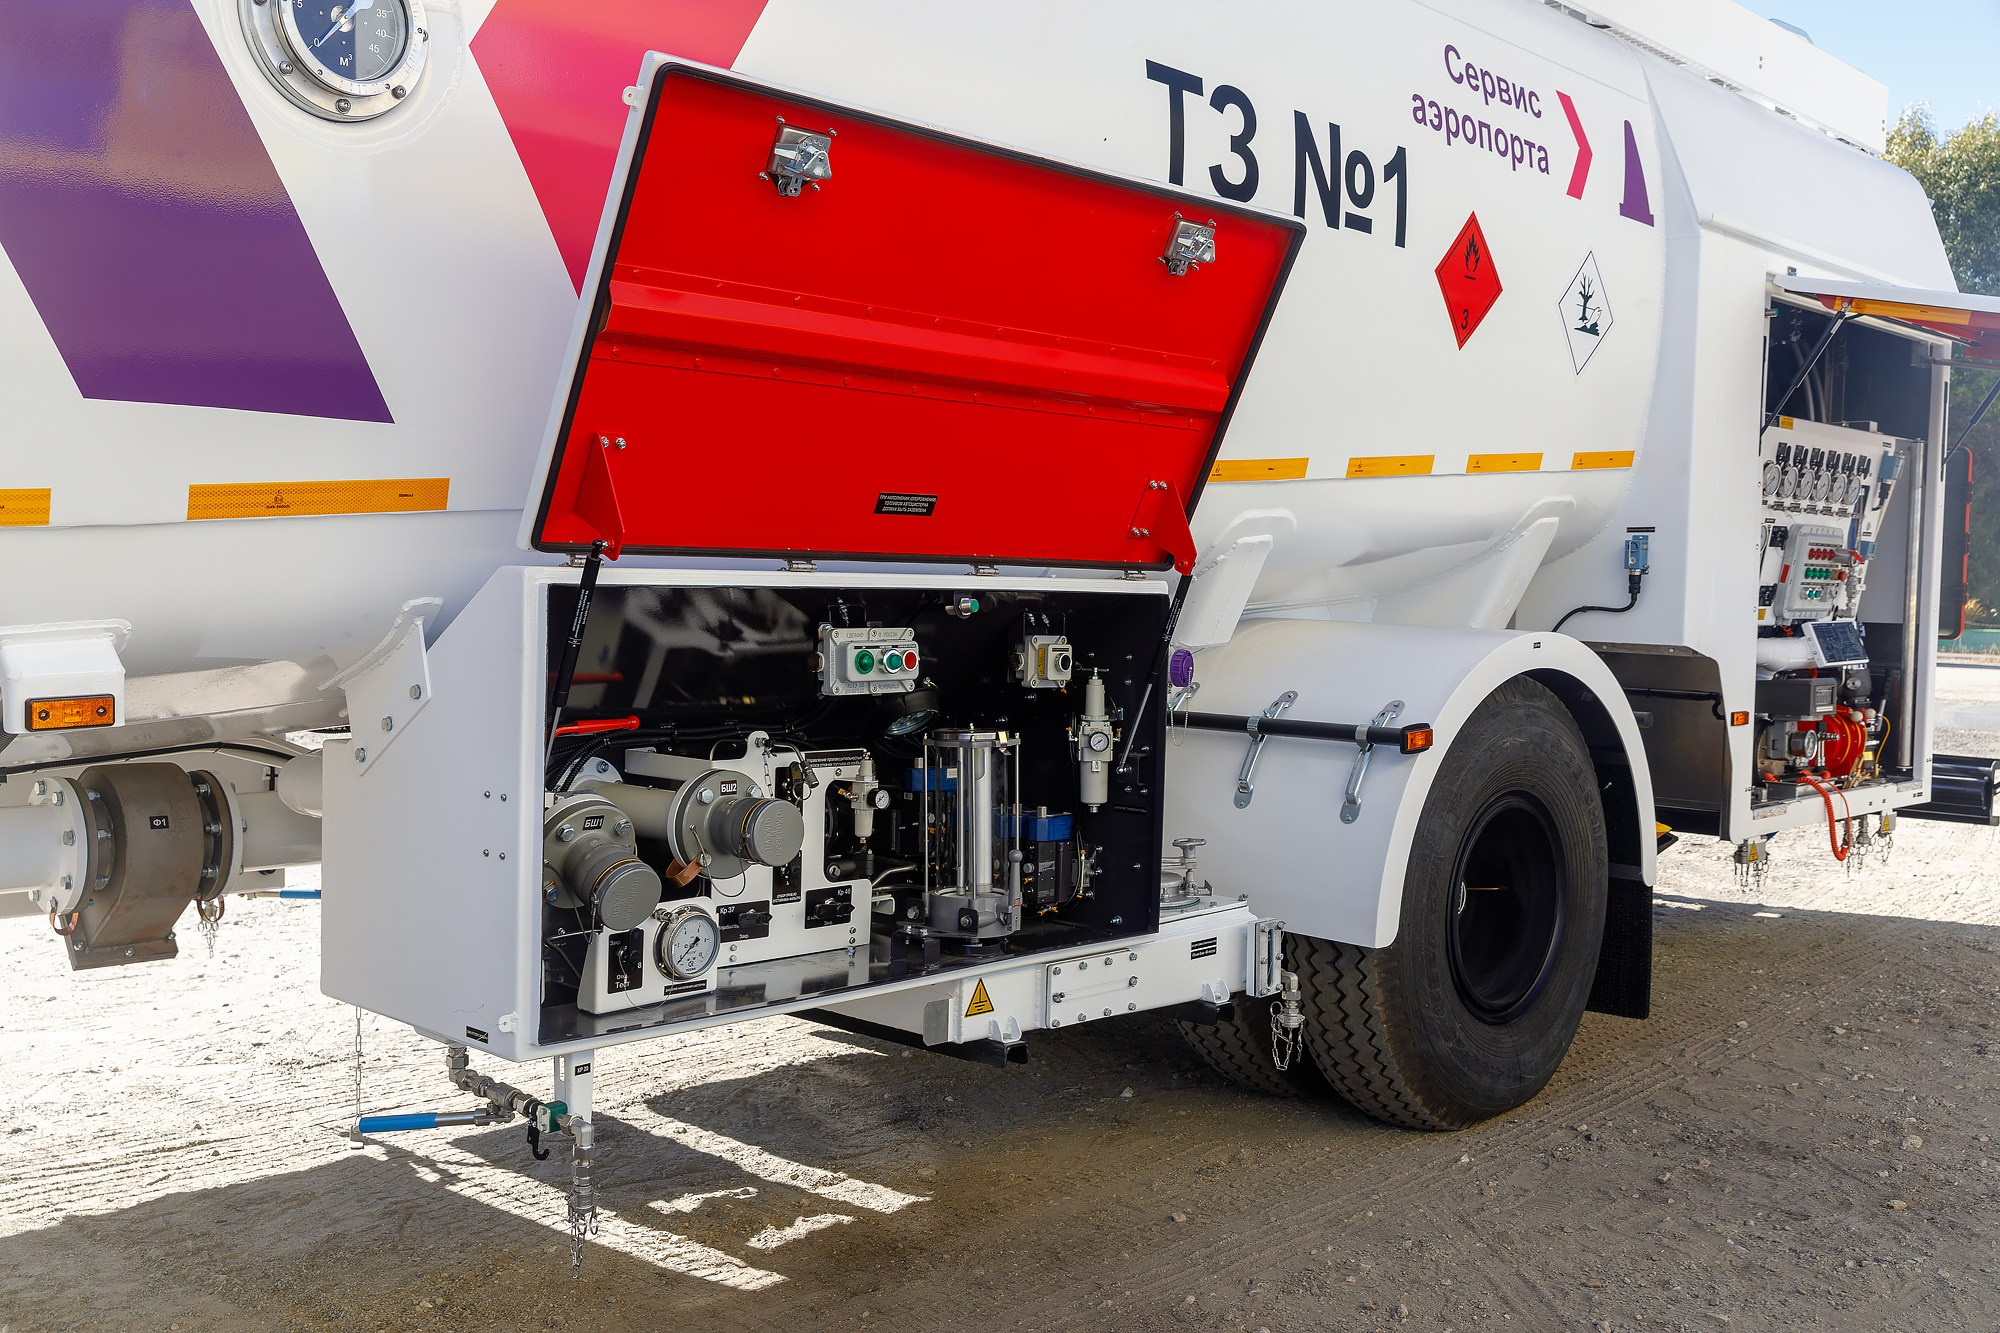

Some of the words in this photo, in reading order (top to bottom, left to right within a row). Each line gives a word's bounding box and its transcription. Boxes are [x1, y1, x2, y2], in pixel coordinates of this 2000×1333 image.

[376, 9, 387, 18] 35
[375, 29, 387, 38] 40
[313, 37, 320, 47] 0
[368, 43, 380, 53] 45
[1444, 44, 1542, 119] Сервис
[1412, 93, 1550, 175] аэропорта
[1293, 109, 1407, 249] №1
[1460, 308, 1469, 330] 3
[721, 782, 737, 793] БШ2
[152, 818, 166, 827] Ф1
[584, 816, 603, 828] БШ1
[727, 906, 736, 914] 37
[637, 961, 642, 969] 8
